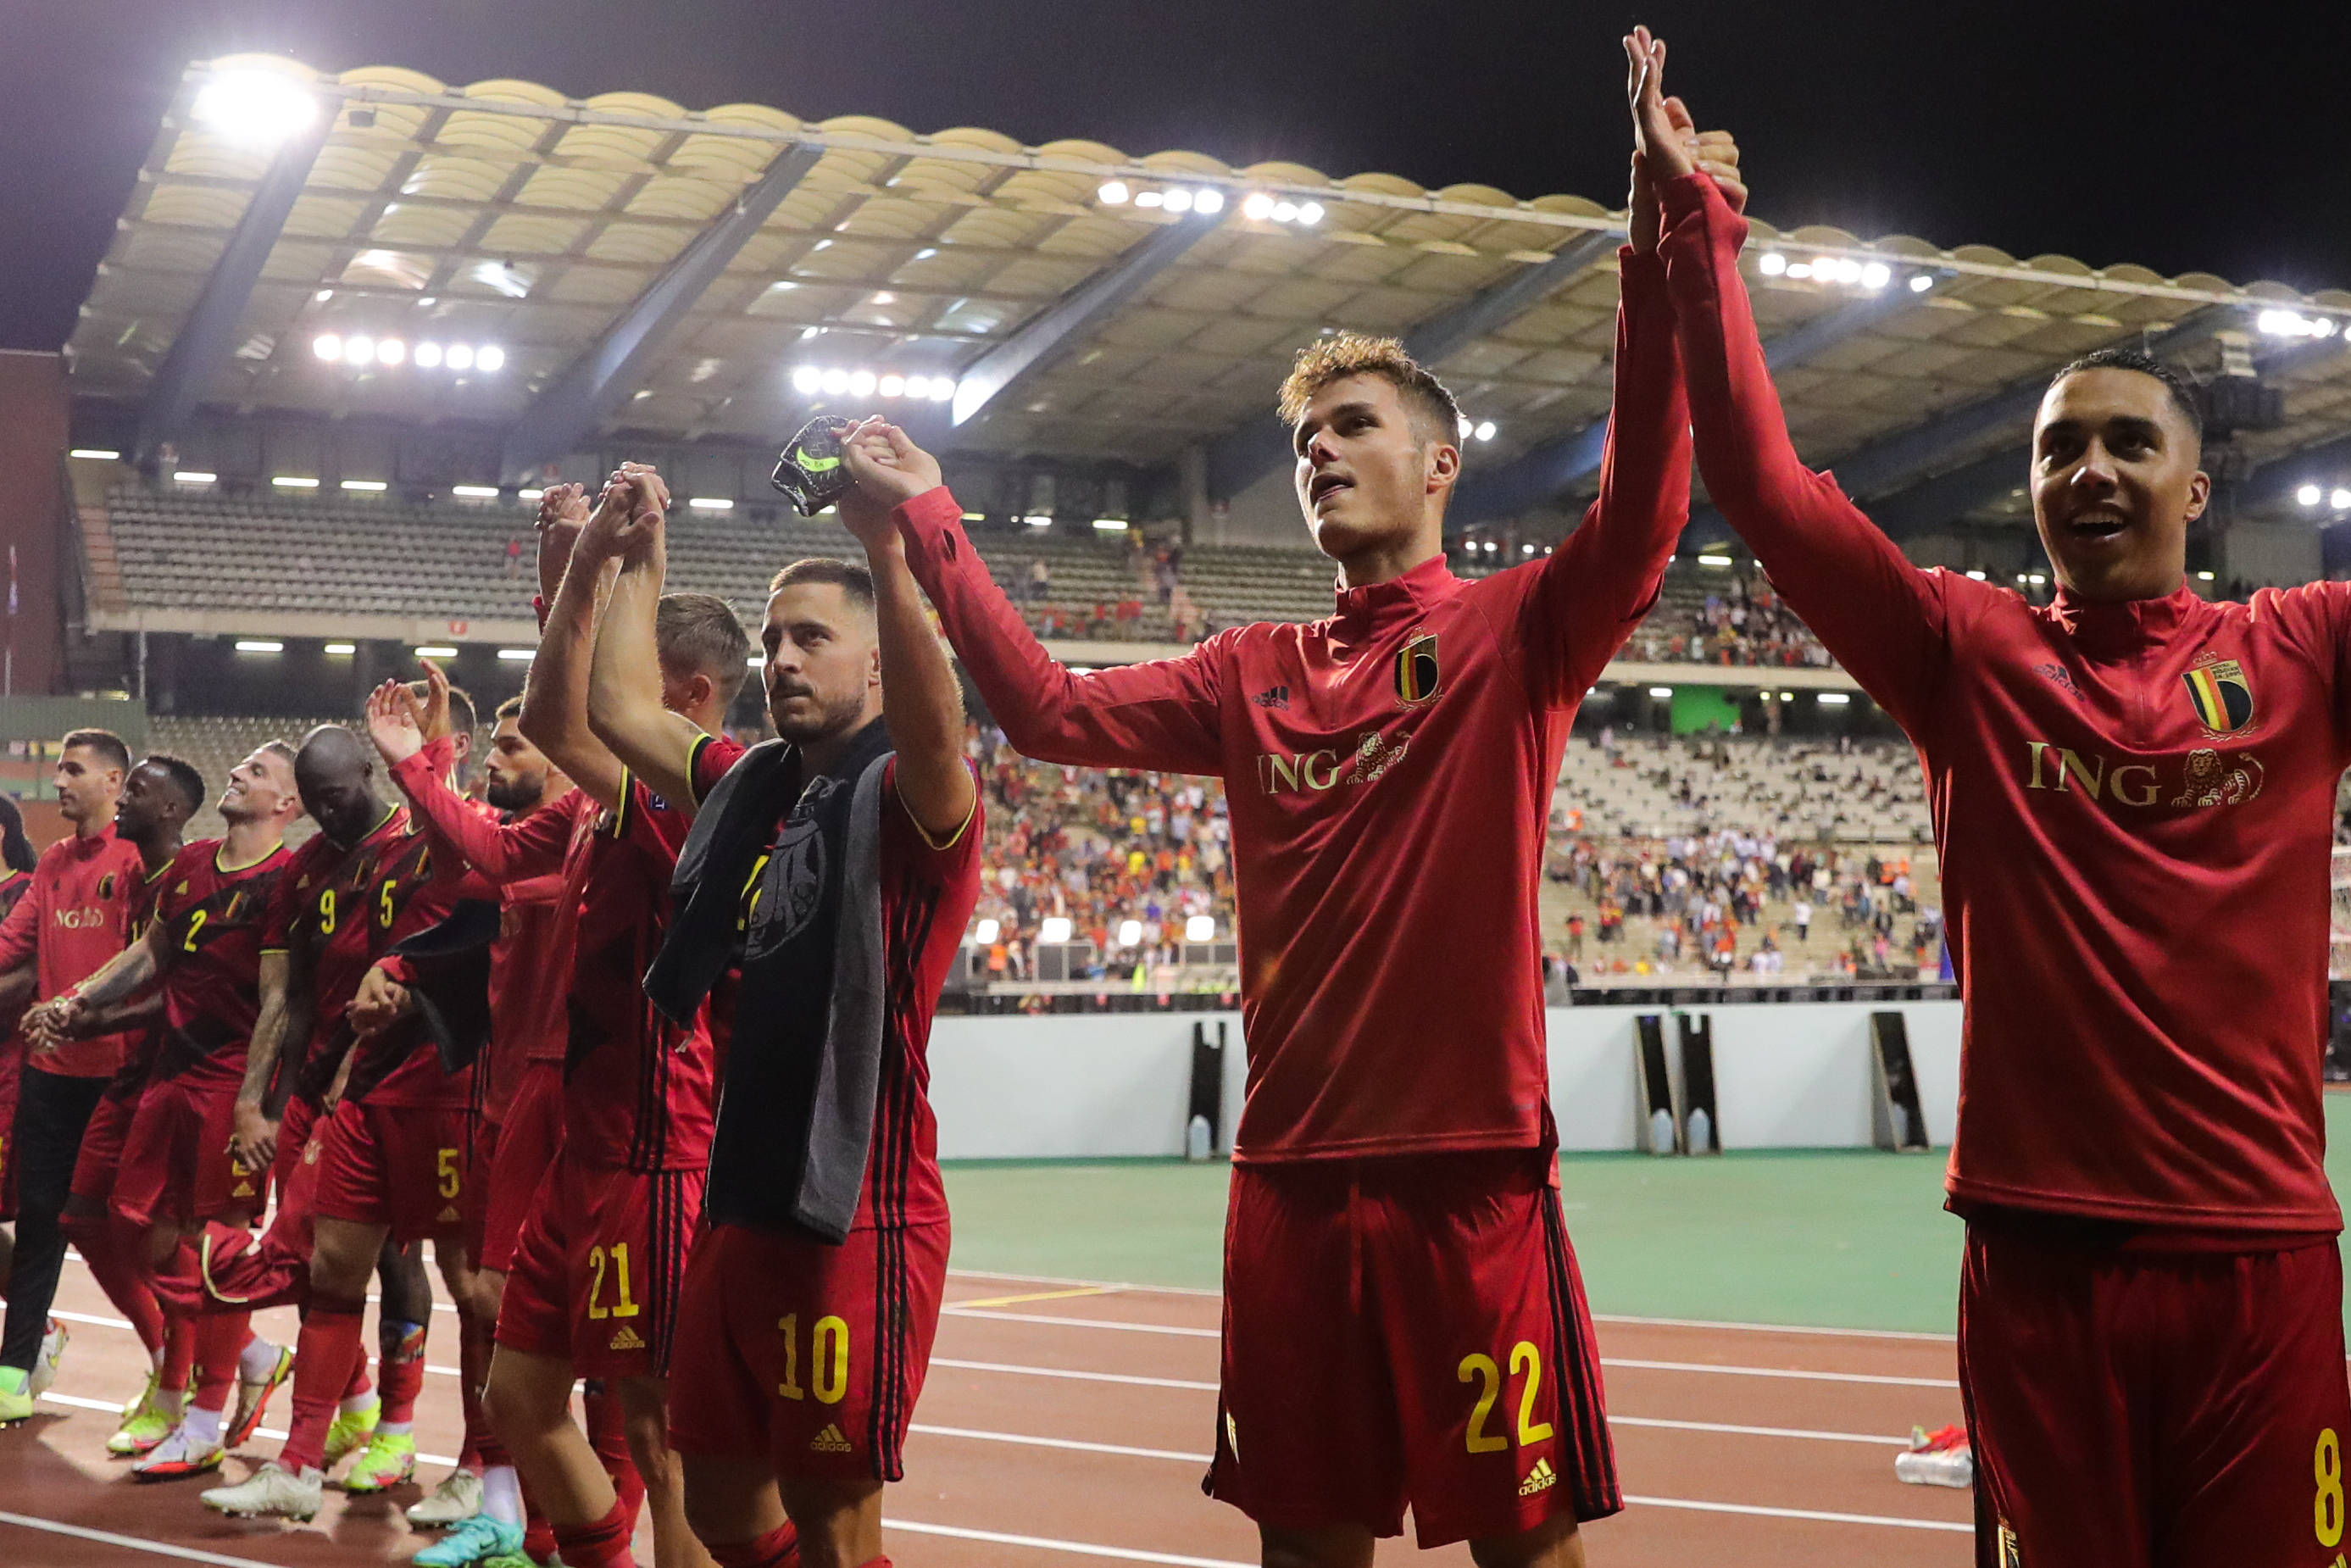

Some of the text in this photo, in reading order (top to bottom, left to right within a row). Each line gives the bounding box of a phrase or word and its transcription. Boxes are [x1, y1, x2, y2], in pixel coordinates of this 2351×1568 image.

[1257, 748, 1342, 794] ING
[2026, 741, 2162, 806] ING
[53, 909, 80, 929] NG
[320, 889, 336, 934] 9
[381, 880, 397, 928] 5
[184, 909, 207, 952] 2
[438, 1148, 460, 1198] 5
[589, 1243, 639, 1320] 21
[778, 1313, 849, 1404] 10
[1458, 1341, 1553, 1454] 22
[810, 1441, 851, 1453] adidas
[1518, 1473, 1557, 1496] adidas
[2315, 1427, 2344, 1548] 8
